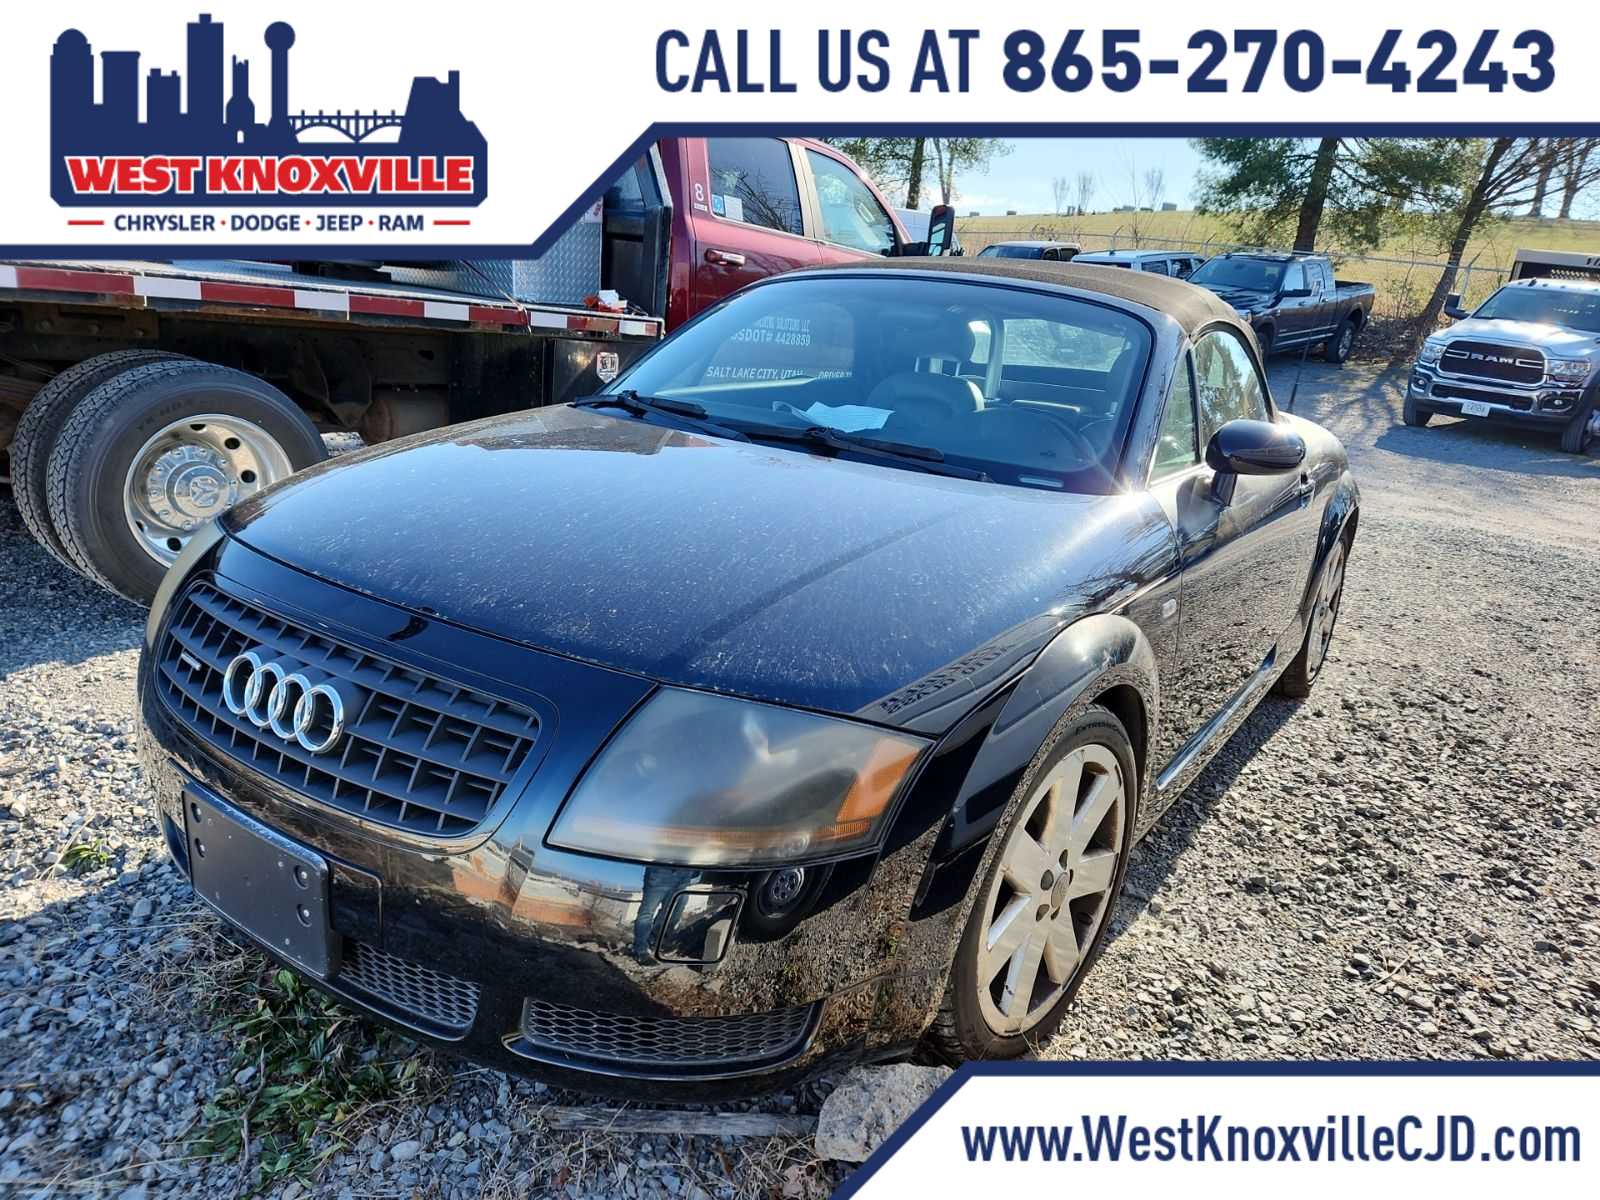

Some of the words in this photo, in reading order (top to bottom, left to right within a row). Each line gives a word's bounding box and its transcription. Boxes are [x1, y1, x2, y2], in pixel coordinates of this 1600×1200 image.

[694, 183, 705, 202] 8
[1470, 352, 1515, 365] RAM
[706, 366, 732, 378] SALT
[732, 367, 757, 379] LAKE
